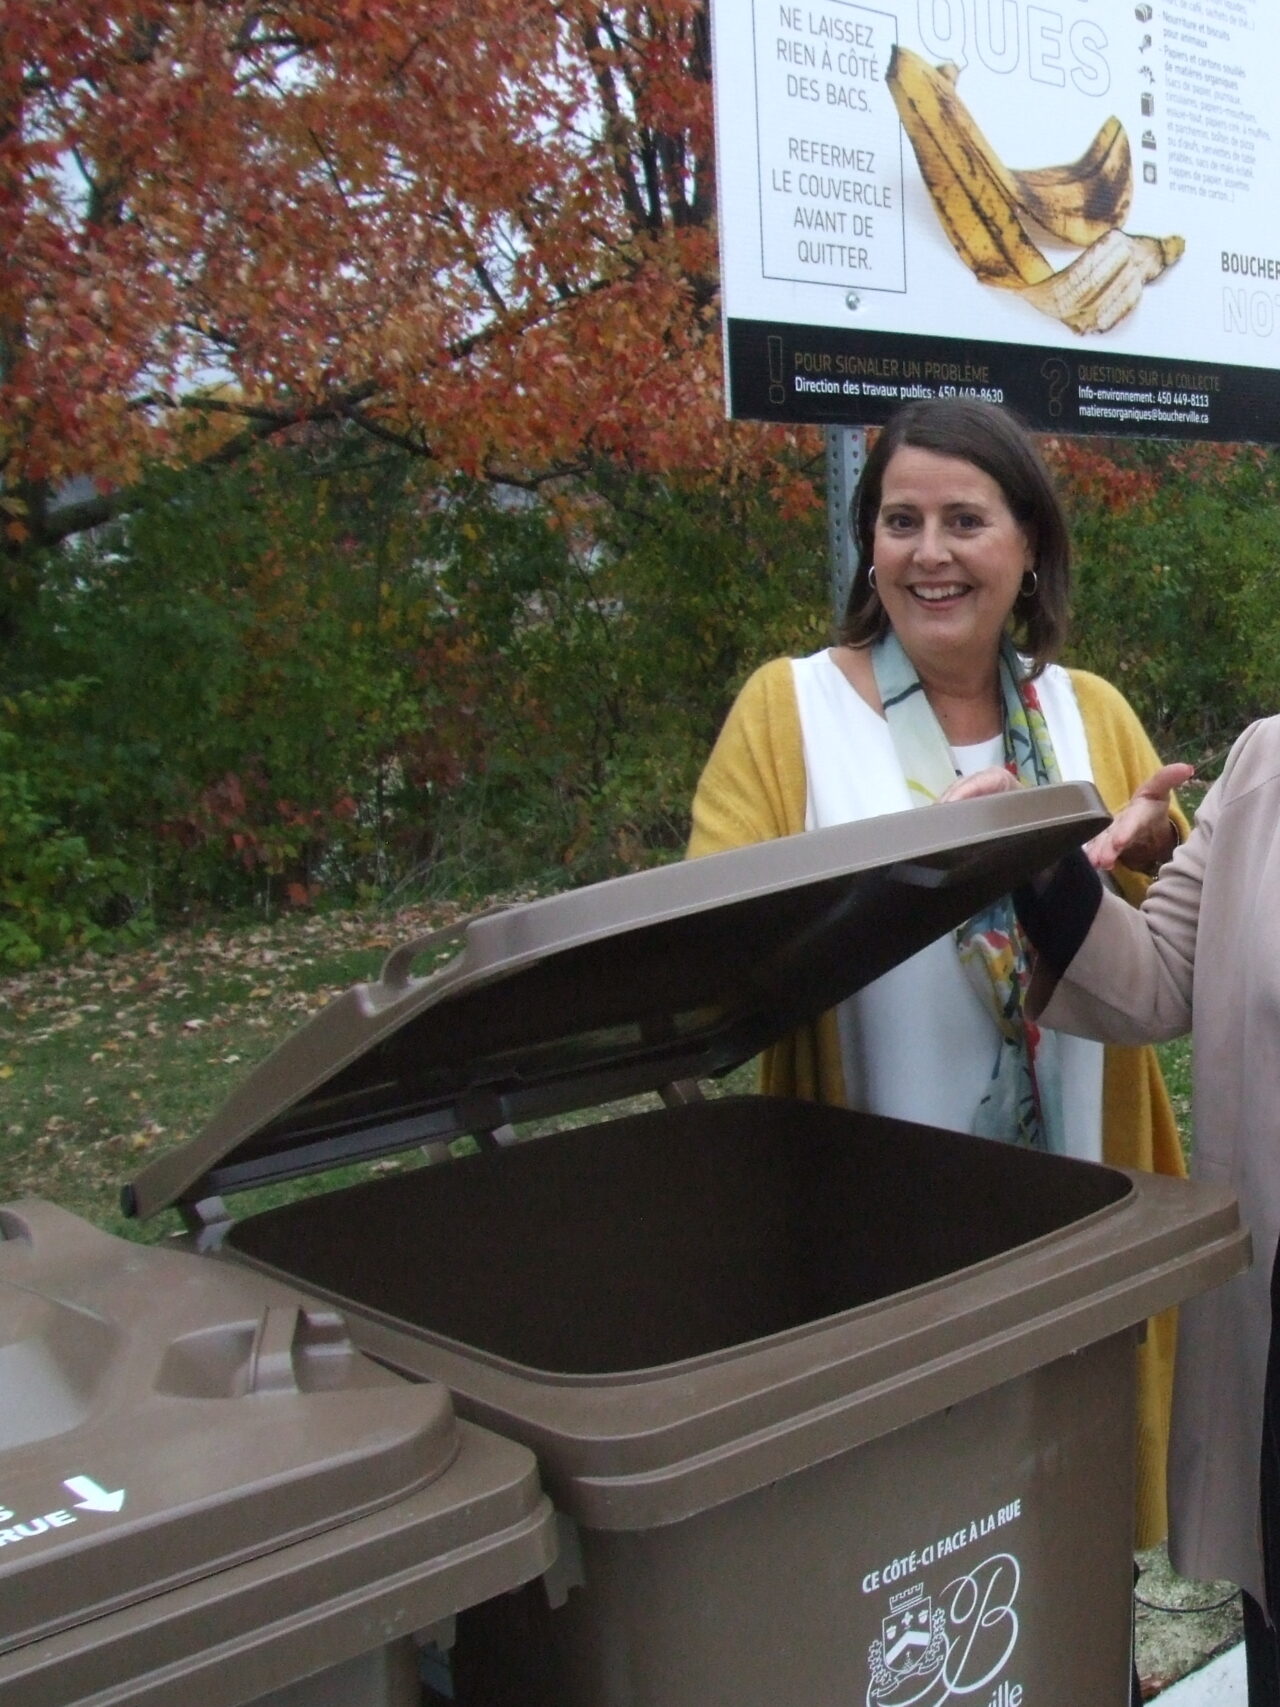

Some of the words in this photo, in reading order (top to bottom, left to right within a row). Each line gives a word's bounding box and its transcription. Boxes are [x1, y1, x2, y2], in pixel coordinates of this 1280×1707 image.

[780, 4, 802, 31] NE
[809, 12, 874, 48] LAISSEZ
[777, 38, 815, 68] RIEN
[822, 42, 832, 72] À
[838, 48, 879, 82] CÔTÉ
[917, 0, 1111, 97] QUES
[787, 74, 820, 102] DES
[827, 83, 872, 113] BACS.
[789, 137, 875, 174] REFERMEZ
[772, 168, 792, 193] LE
[799, 173, 892, 209] COUVERCLE
[794, 206, 847, 234] AVANT
[853, 214, 874, 238] DE
[798, 240, 872, 270] QUITTER.
[794, 352, 832, 372] POUR
[835, 354, 898, 378] SIGNALER
[903, 361, 920, 378] UN
[924, 359, 990, 383] PROBLÈME
[1078, 365, 1136, 384] QUESTIONS
[1138, 369, 1158, 386] SUR
[1161, 372, 1173, 387] LA
[1175, 373, 1221, 392] COLLECTE
[794, 377, 840, 394] Direction
[843, 380, 859, 395] des
[862, 383, 897, 397] travaux
[901, 385, 936, 400] publics:
[1078, 385, 1156, 404] Info-environnement:
[1157, 391, 1171, 405] 450
[1173, 393, 1209, 407] 449-8113
[1079, 404, 1209, 424] matieresorganiques@boucherville.ca
[862, 1570, 880, 1593] CE
[882, 1545, 933, 1585] CÔTÉ-CI
[937, 1529, 966, 1558] FACE
[969, 1521, 978, 1542] À
[980, 1514, 995, 1536] LA
[997, 1498, 1021, 1527] RUE
